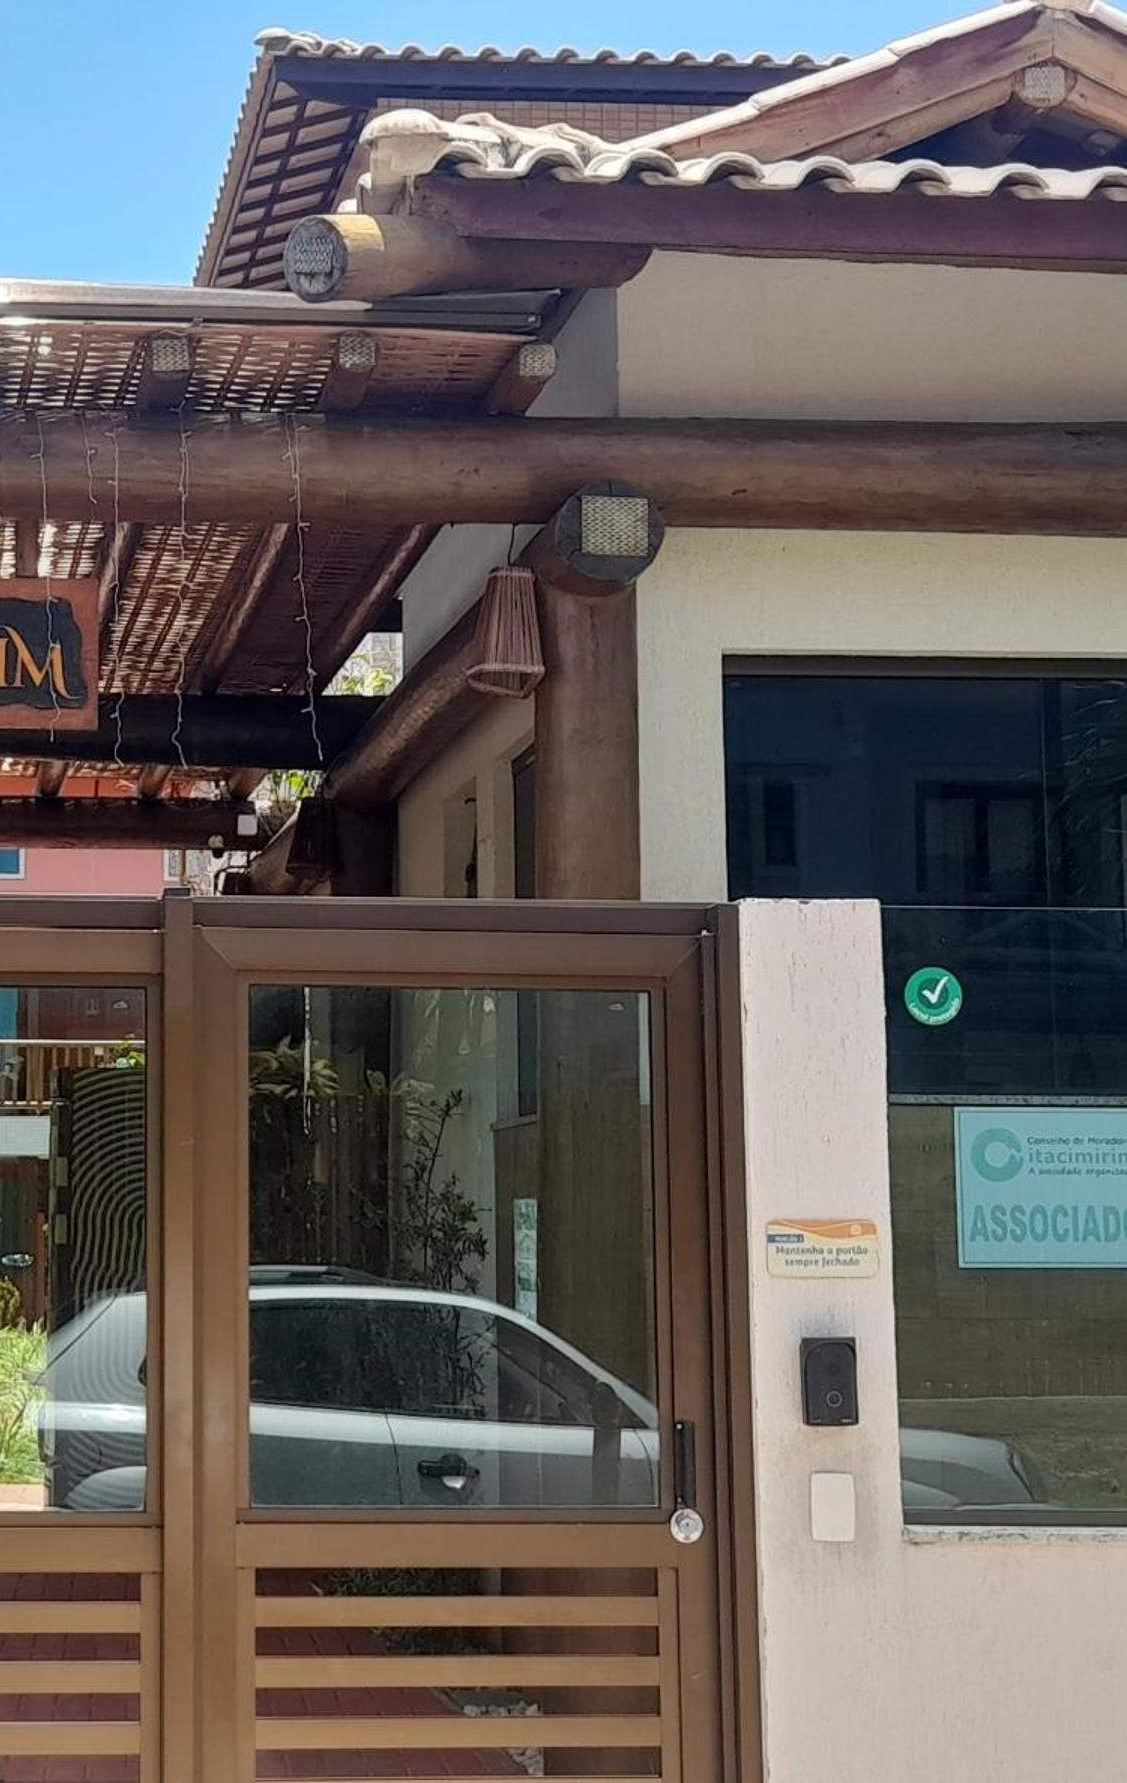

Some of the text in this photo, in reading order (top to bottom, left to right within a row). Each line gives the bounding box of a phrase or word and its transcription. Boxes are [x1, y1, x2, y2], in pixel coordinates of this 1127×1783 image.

[1027, 1136, 1071, 1146] Conselho
[1073, 1136, 1084, 1145] de
[1028, 1167, 1035, 1175] A
[970, 1204, 1127, 1243] ASSOCIAD
[775, 1246, 824, 1255] Mantenha
[836, 1245, 869, 1257] portão
[785, 1257, 861, 1268] sempre fechado
